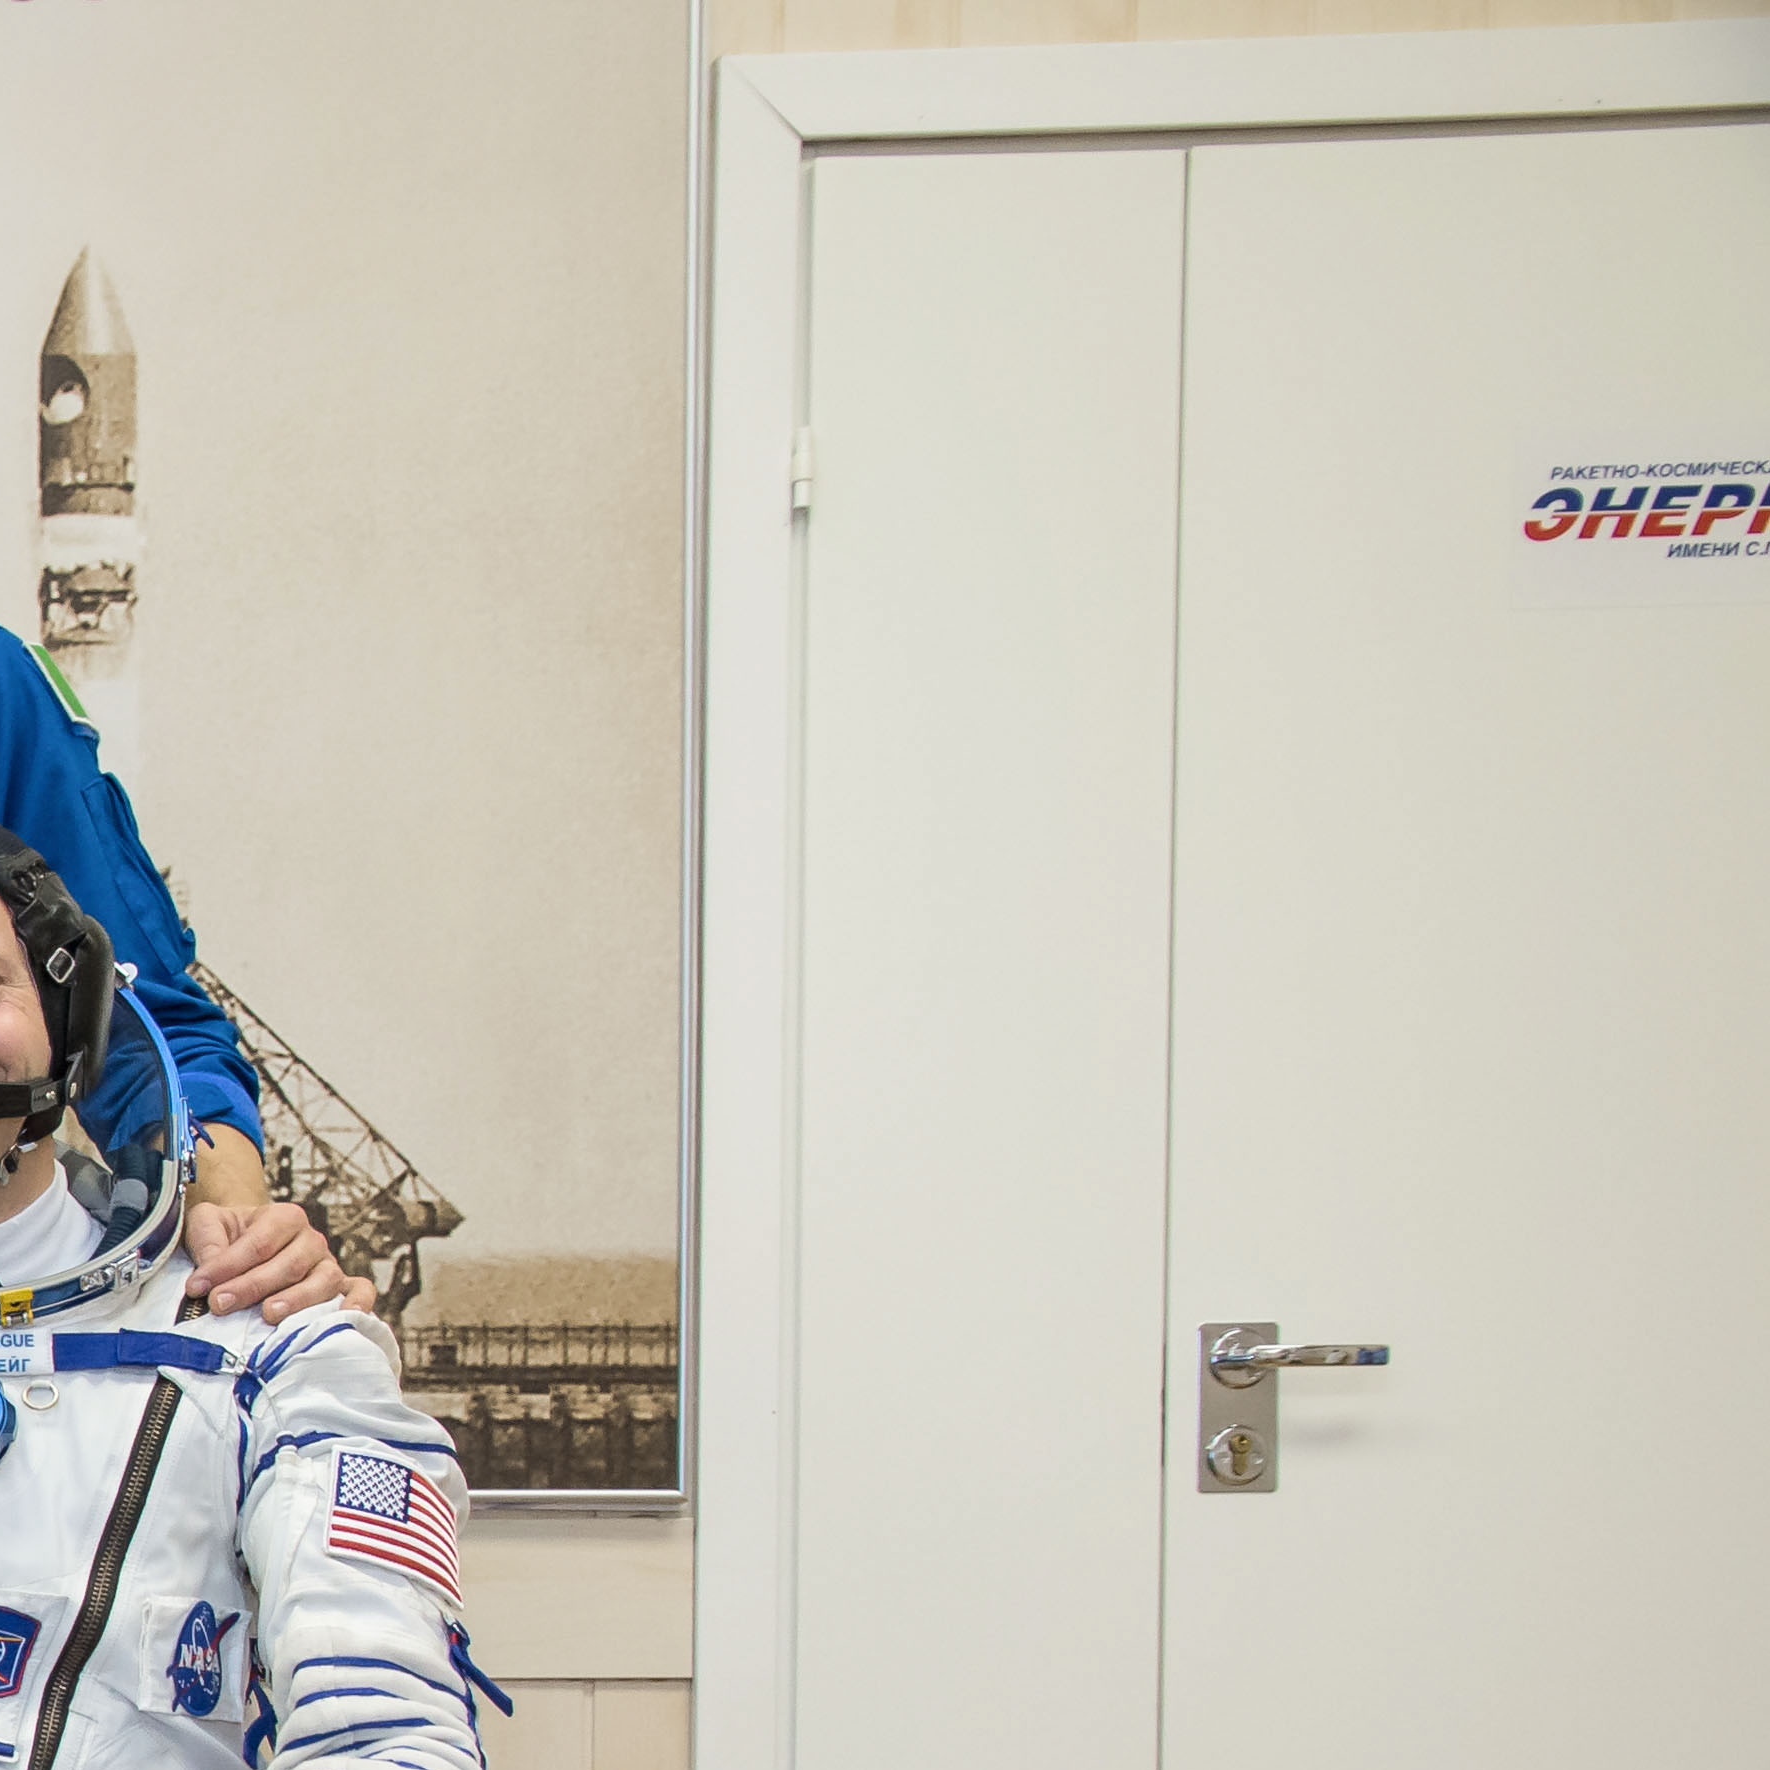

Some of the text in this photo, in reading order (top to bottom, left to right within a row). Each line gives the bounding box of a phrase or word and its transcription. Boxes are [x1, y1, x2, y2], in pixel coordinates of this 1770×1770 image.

[1551, 460, 1770, 480] РАКЕТНО-КОСМИЧЕСК
[1523, 483, 1770, 541] ЭНЕР
[1667, 542, 1740, 558] ИМЕНИ
[178, 1643, 220, 1673] NASA
